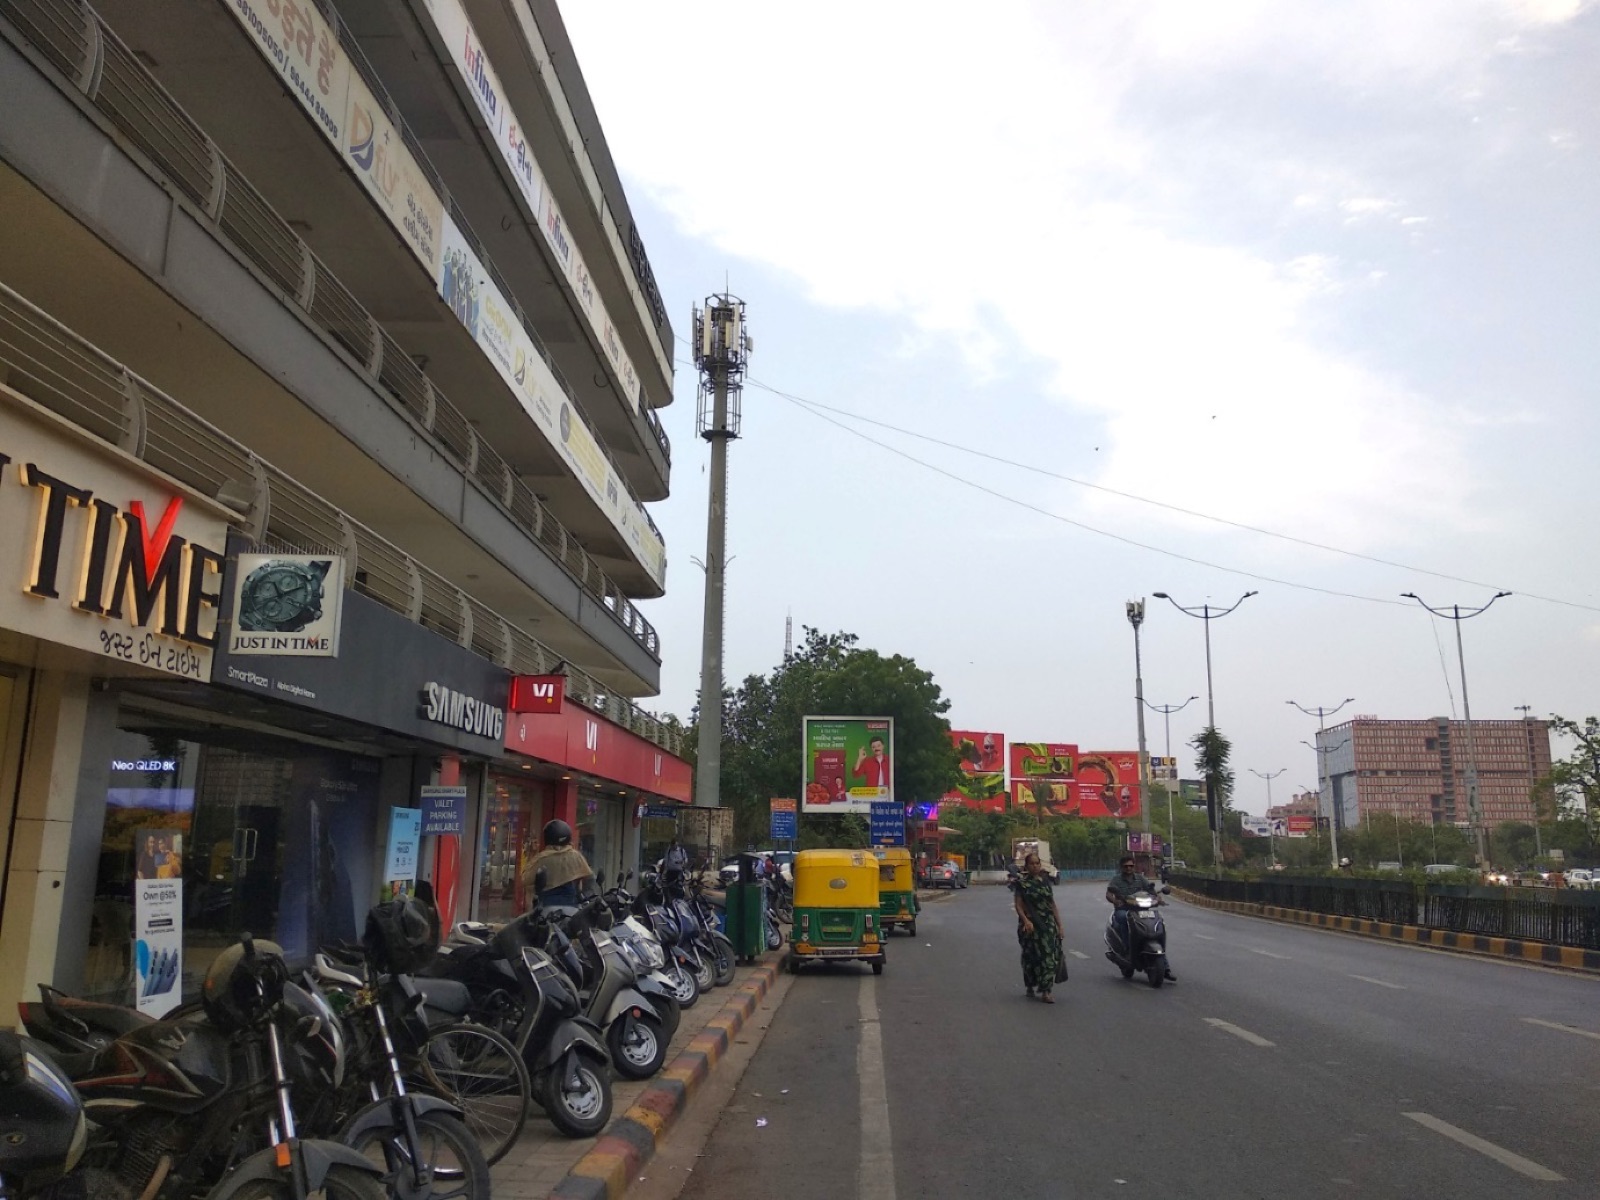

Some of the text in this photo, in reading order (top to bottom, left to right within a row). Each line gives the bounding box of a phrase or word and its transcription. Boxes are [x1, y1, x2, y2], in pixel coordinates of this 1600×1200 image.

[18, 462, 227, 649] TIME
[232, 634, 329, 651] JUST IN TIME
[422, 682, 504, 741] SAMSUNG
[112, 760, 176, 771] Neo QLED 8K
[434, 800, 455, 808] VALET
[429, 811, 458, 820] PARKING
[425, 822, 460, 832] AVAILABLE
[143, 892, 159, 900] Own
